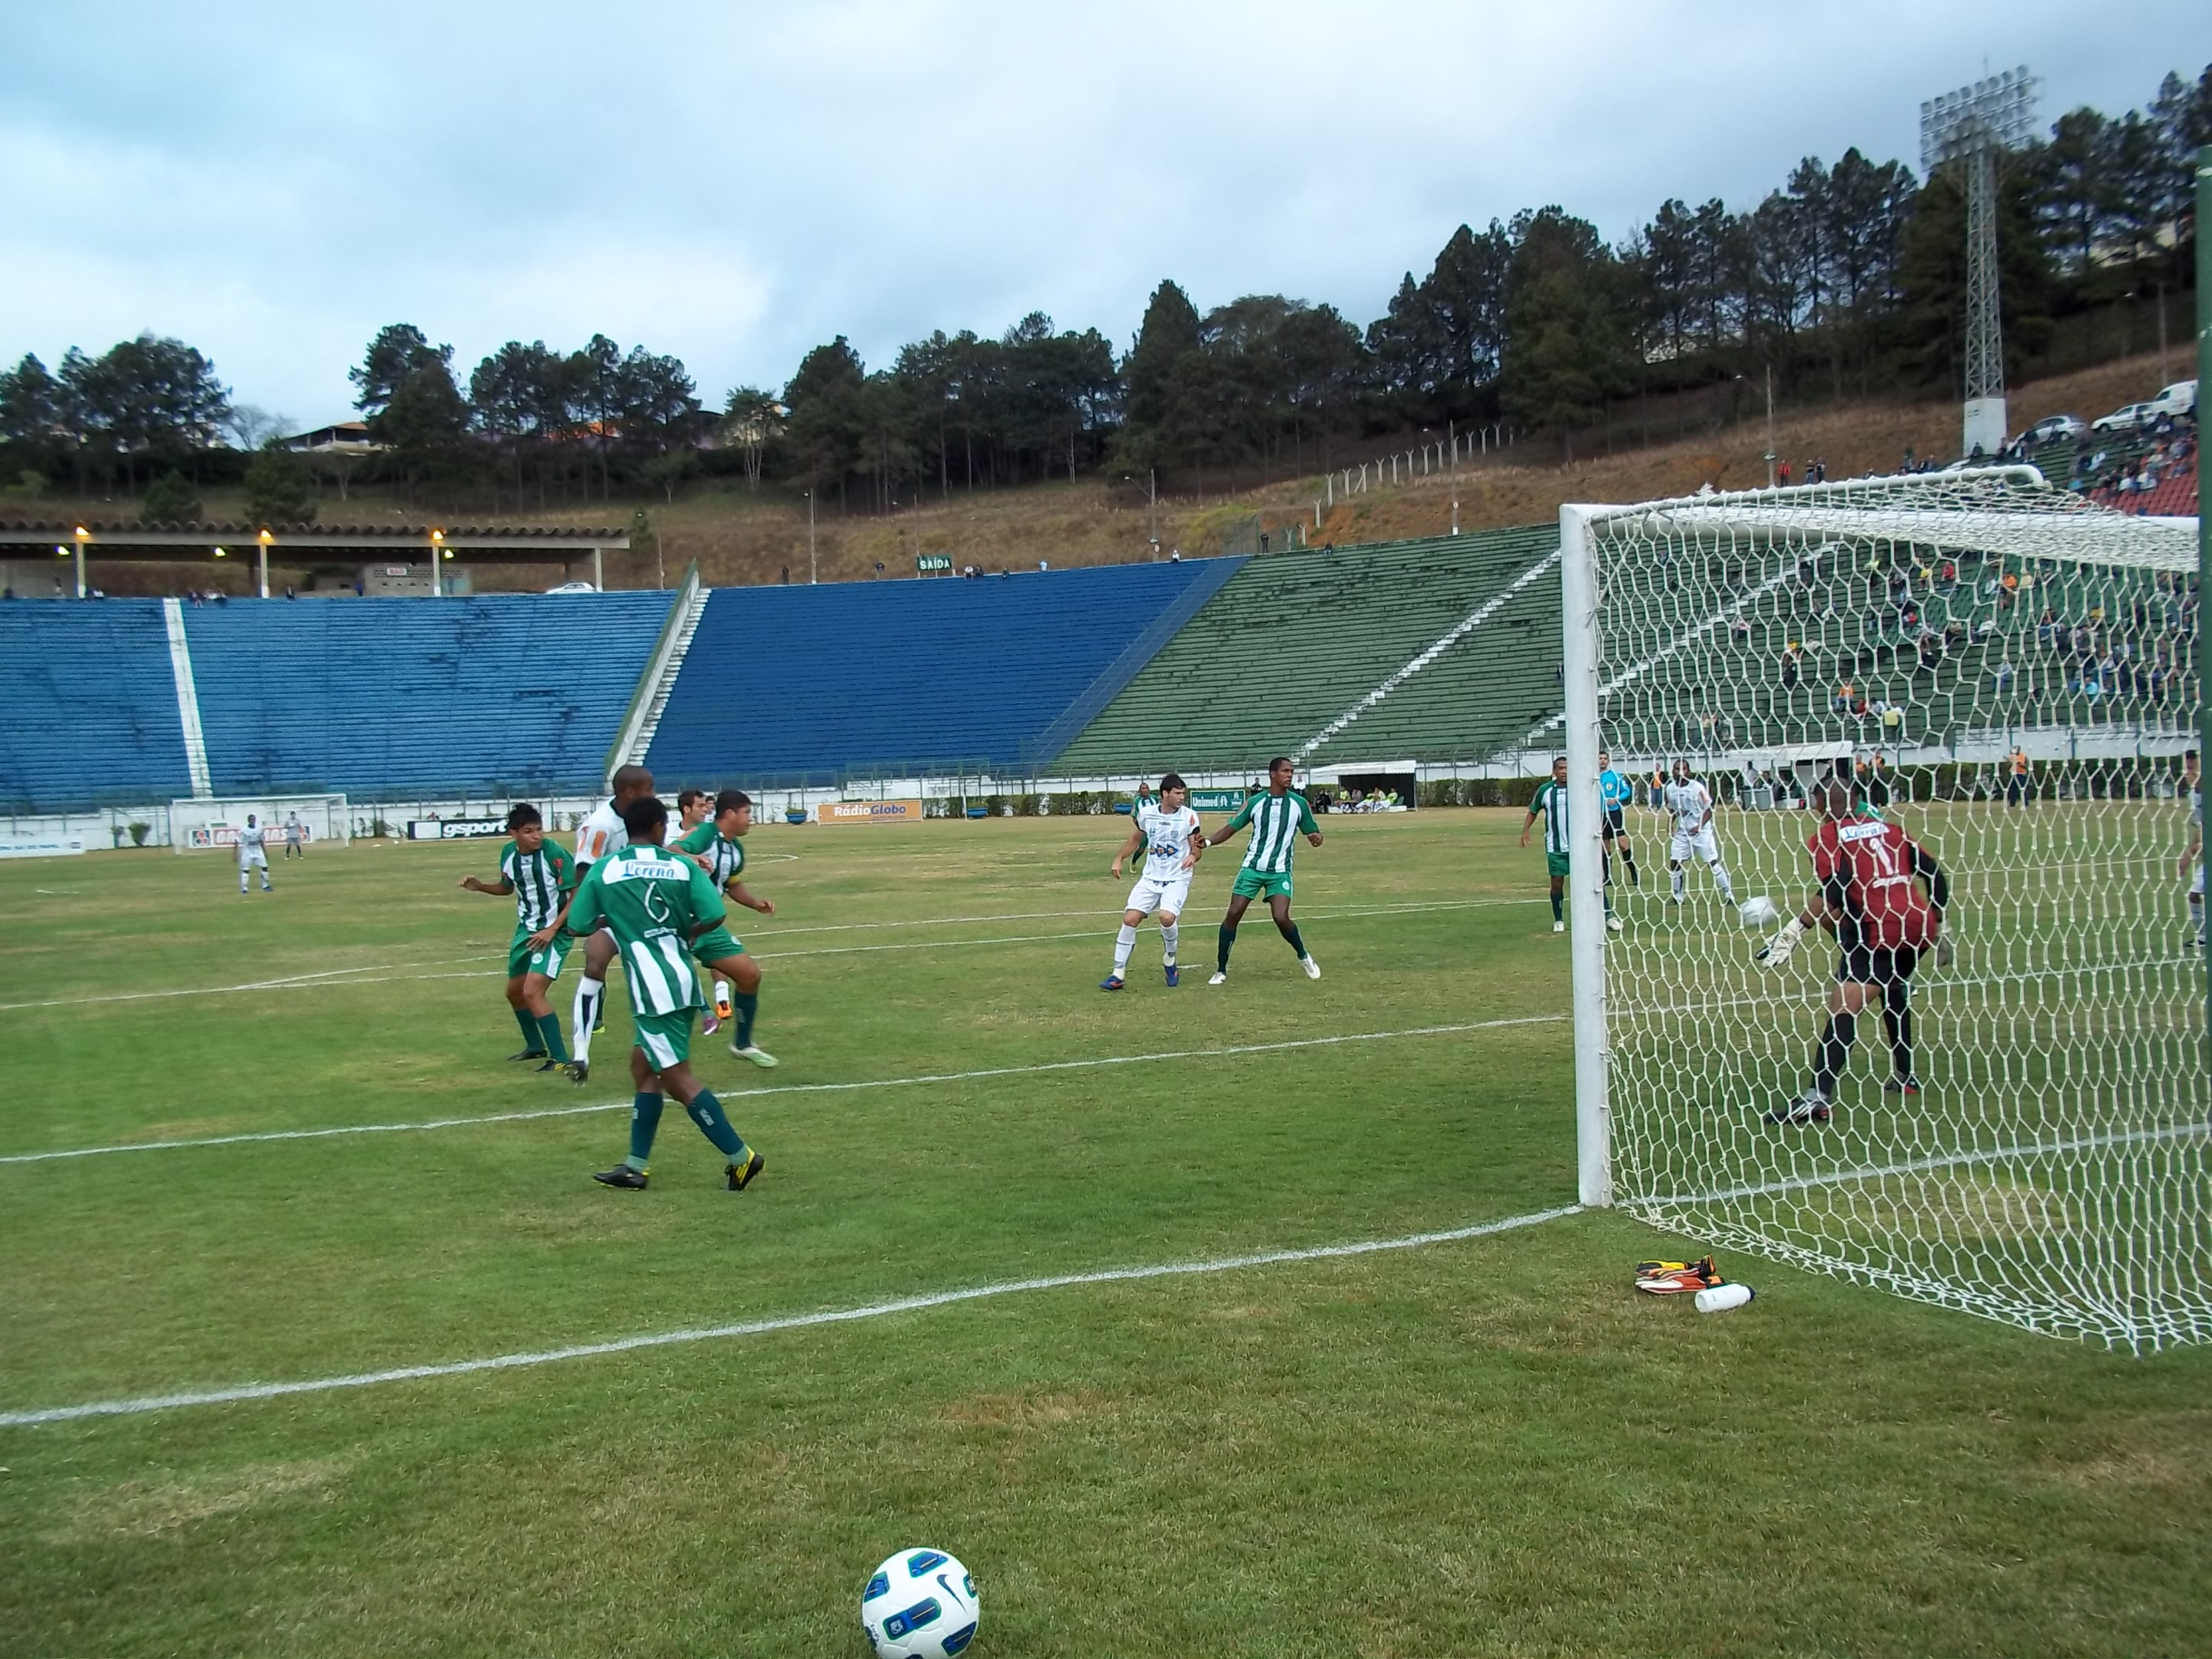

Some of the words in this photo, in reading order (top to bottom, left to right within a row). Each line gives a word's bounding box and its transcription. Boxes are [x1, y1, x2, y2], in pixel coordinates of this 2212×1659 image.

[1192, 796, 1218, 807] Unimed
[442, 820, 508, 838] gsport
[1869, 837, 1894, 876] 1
[621, 861, 675, 878] Lorena
[644, 881, 670, 923] 6
